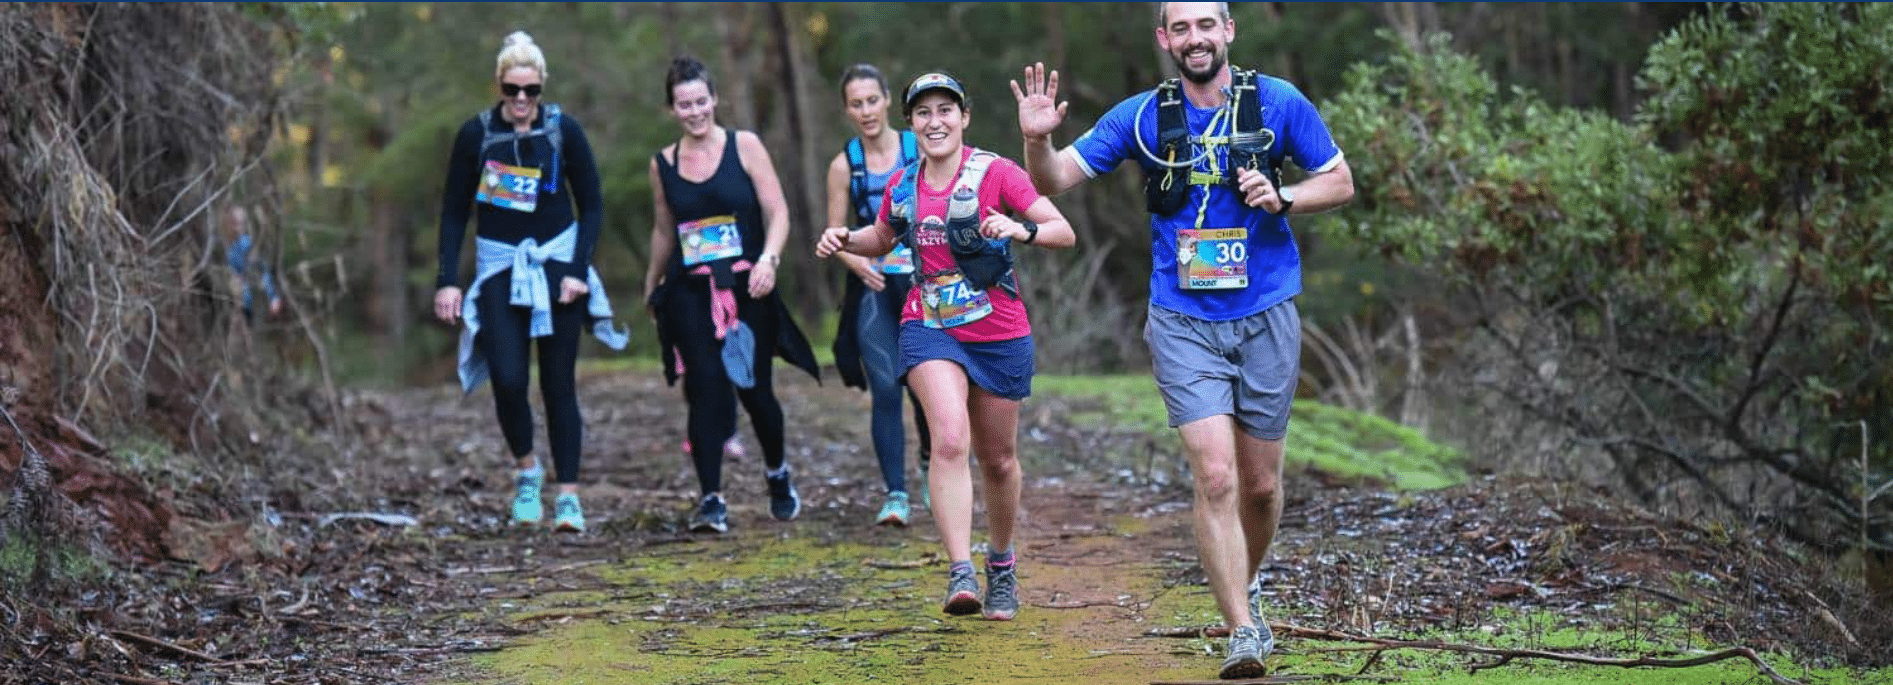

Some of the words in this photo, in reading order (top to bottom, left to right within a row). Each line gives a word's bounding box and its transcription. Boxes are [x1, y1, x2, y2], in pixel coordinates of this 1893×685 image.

[513, 176, 537, 194] 22
[719, 224, 738, 246] 21
[1216, 230, 1242, 239] CHRIS
[1215, 241, 1246, 264] 30
[1192, 279, 1217, 287] MOUNT
